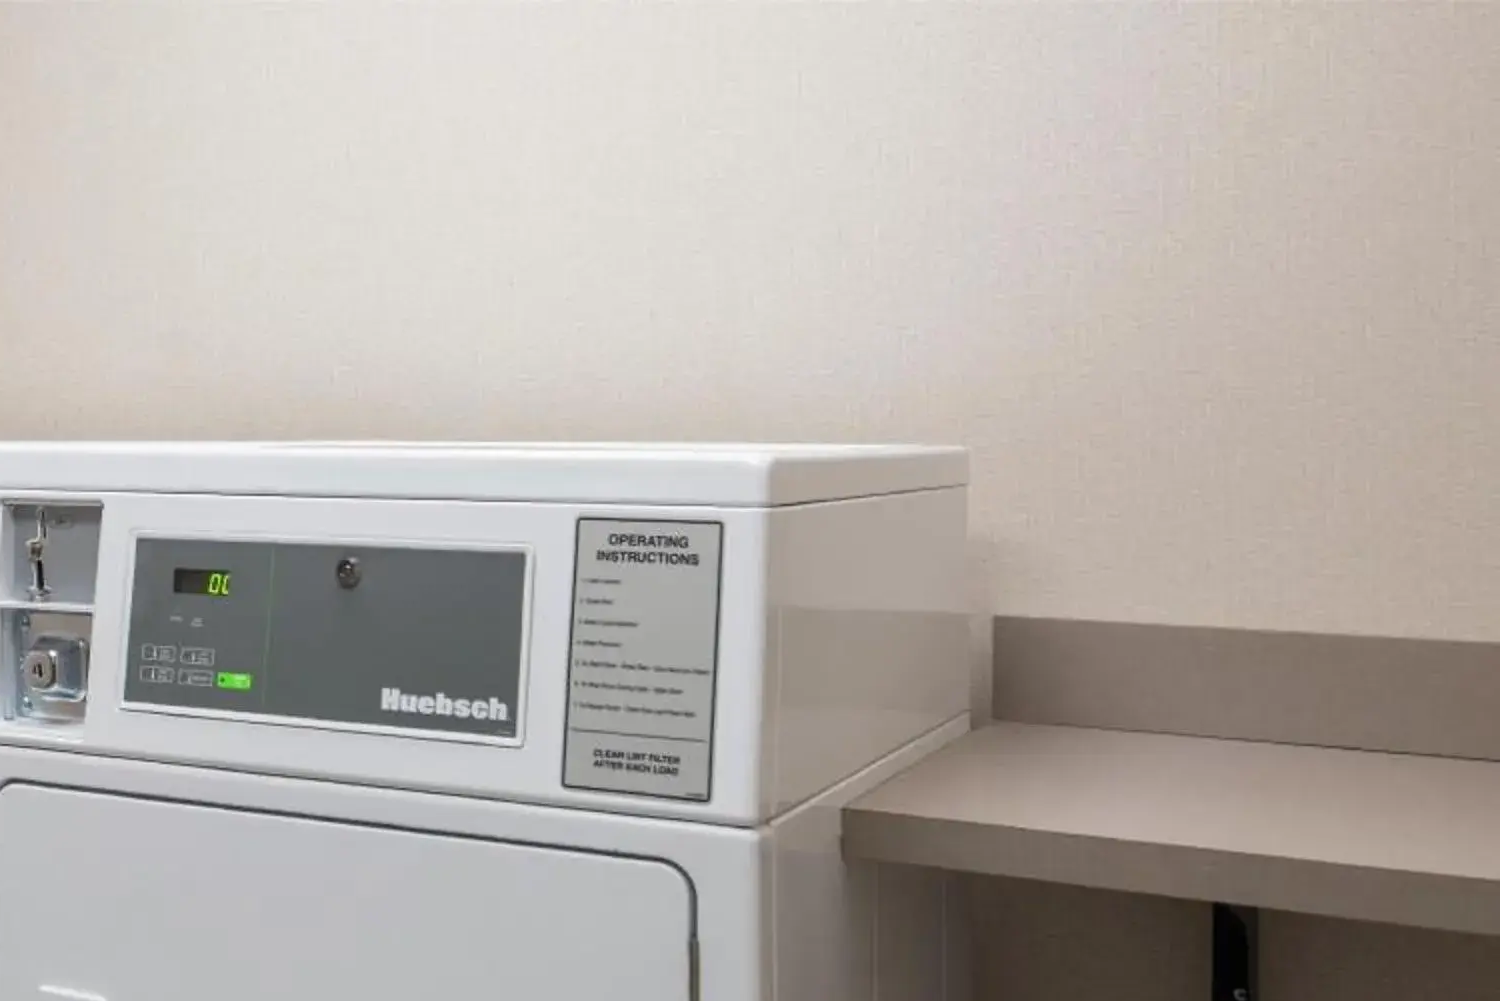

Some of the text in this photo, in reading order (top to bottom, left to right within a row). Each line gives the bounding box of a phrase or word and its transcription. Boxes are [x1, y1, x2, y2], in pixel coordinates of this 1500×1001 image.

[608, 533, 689, 549] OPERATING
[596, 549, 700, 566] INSTRUCTIONS
[381, 687, 509, 721] Huebsch
[593, 759, 624, 770] AFTER
